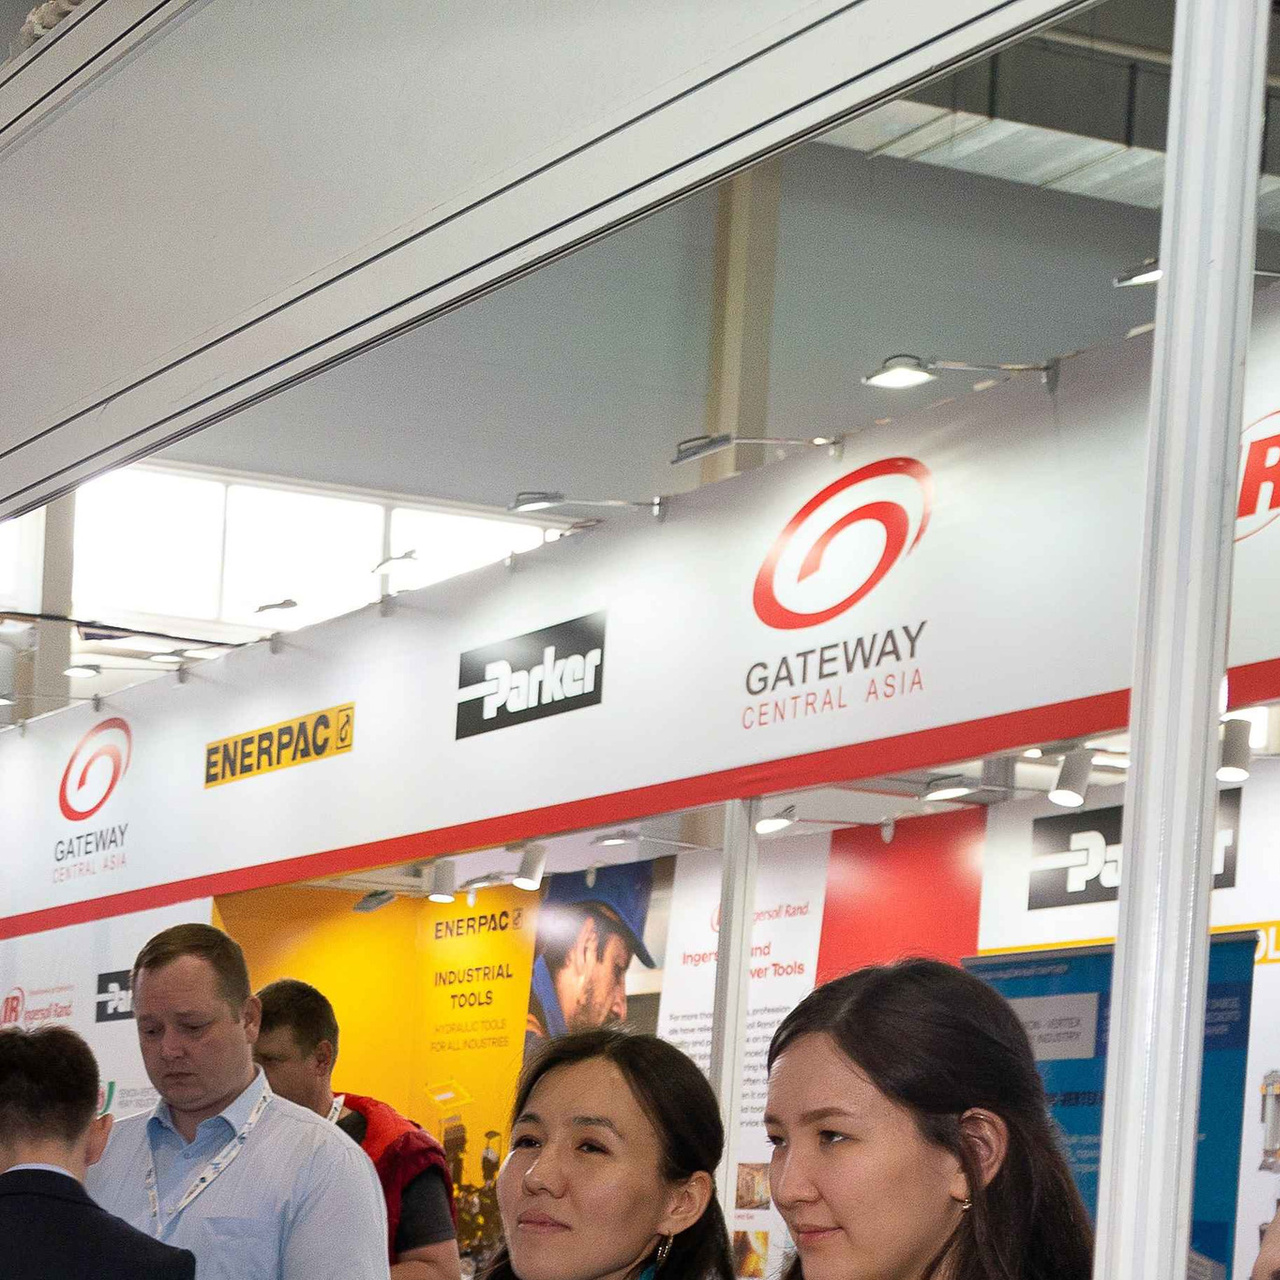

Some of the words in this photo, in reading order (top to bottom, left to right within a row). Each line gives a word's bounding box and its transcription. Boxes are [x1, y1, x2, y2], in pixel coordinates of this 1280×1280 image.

[745, 620, 928, 697] GATEWAY
[483, 645, 602, 721] Parker
[742, 686, 847, 730] CENTRAL
[866, 667, 924, 705] ASIA
[206, 713, 332, 785] ENERPAC
[54, 822, 130, 862] GATEWAY
[52, 861, 97, 883] CENTRAL
[101, 854, 127, 871] ASIA
[434, 910, 510, 940] ENERPAC
[434, 963, 514, 987] INDUSTRIAL
[772, 961, 805, 977] Tools
[450, 990, 494, 1009] TOOLS
[481, 1018, 507, 1031] TOOLS
[431, 1041, 446, 1052] FOR
[447, 1039, 461, 1050] ALL
[463, 1036, 509, 1049] INDUSTRIES
